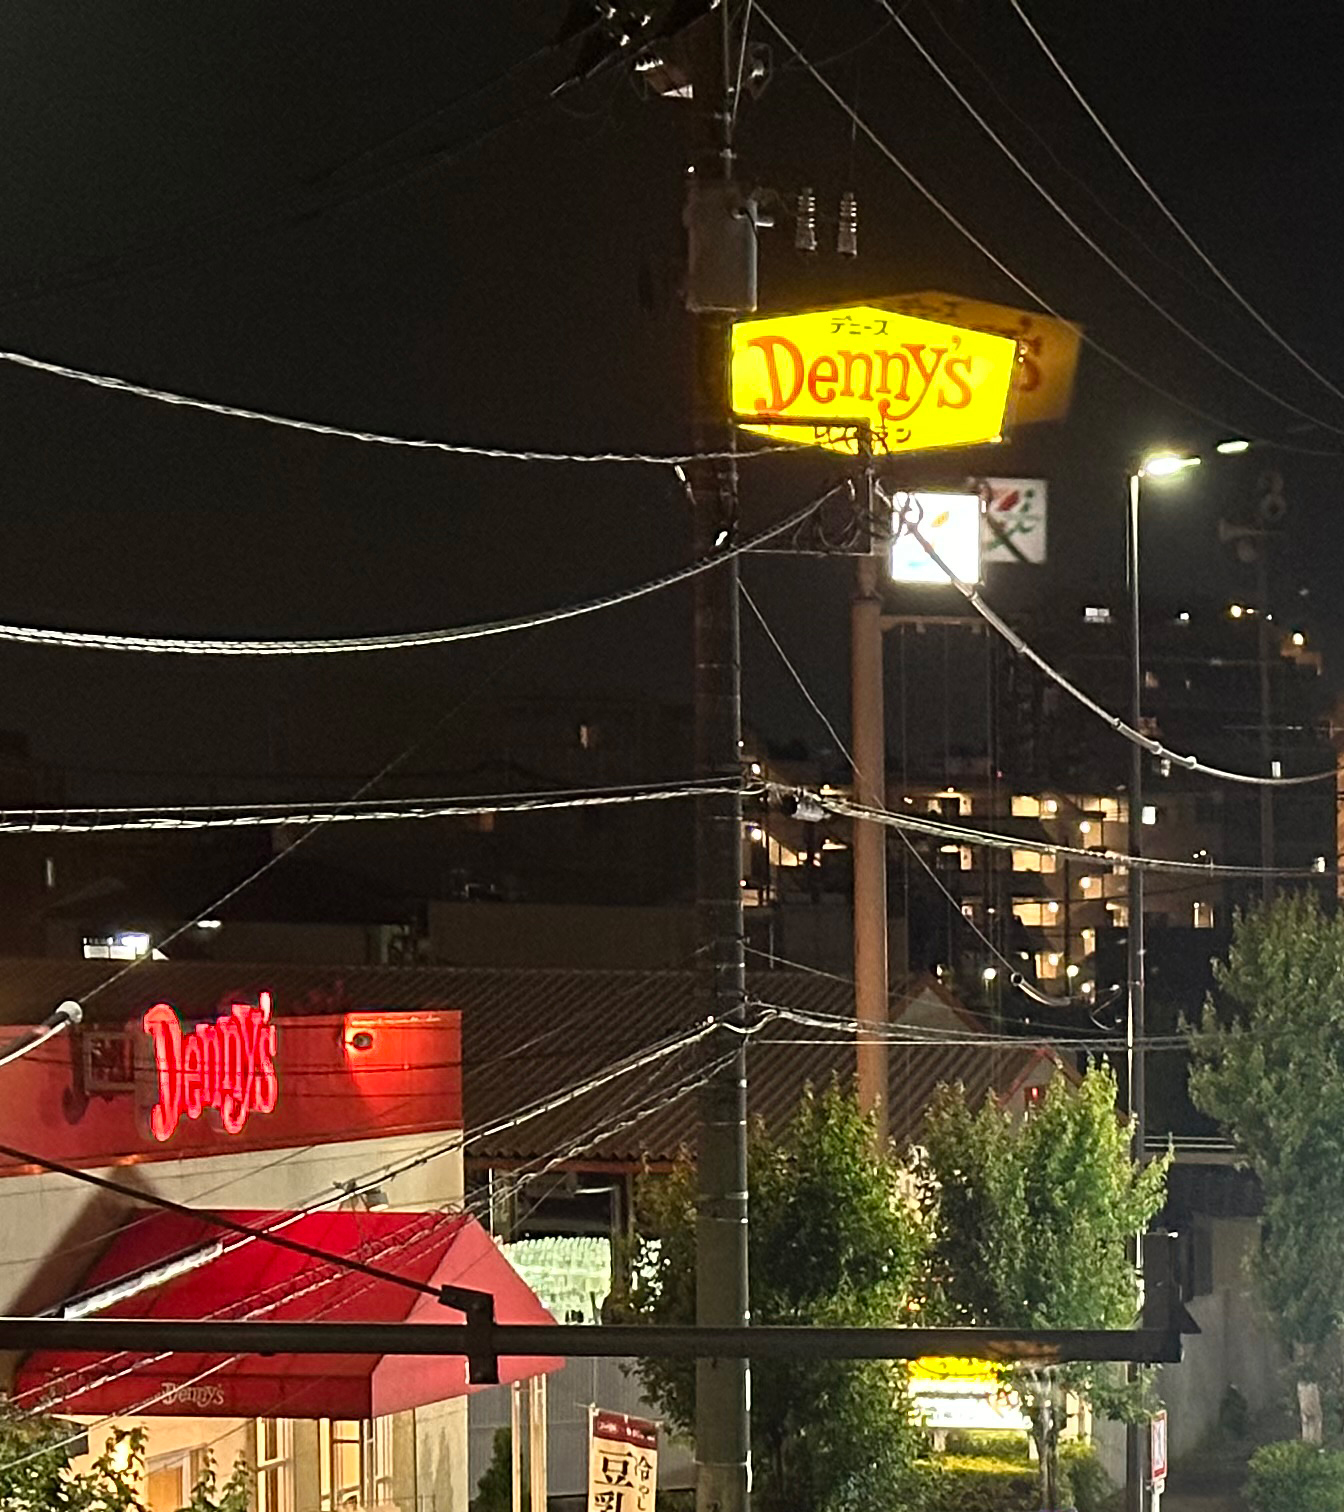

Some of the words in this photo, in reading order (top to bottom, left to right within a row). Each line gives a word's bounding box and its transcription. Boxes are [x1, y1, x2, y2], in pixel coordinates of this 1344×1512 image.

[747, 335, 972, 421] Denny's
[143, 992, 278, 1141] Denny's
[161, 1382, 225, 1407] Denny's
[634, 1456, 653, 1512] 冷やし
